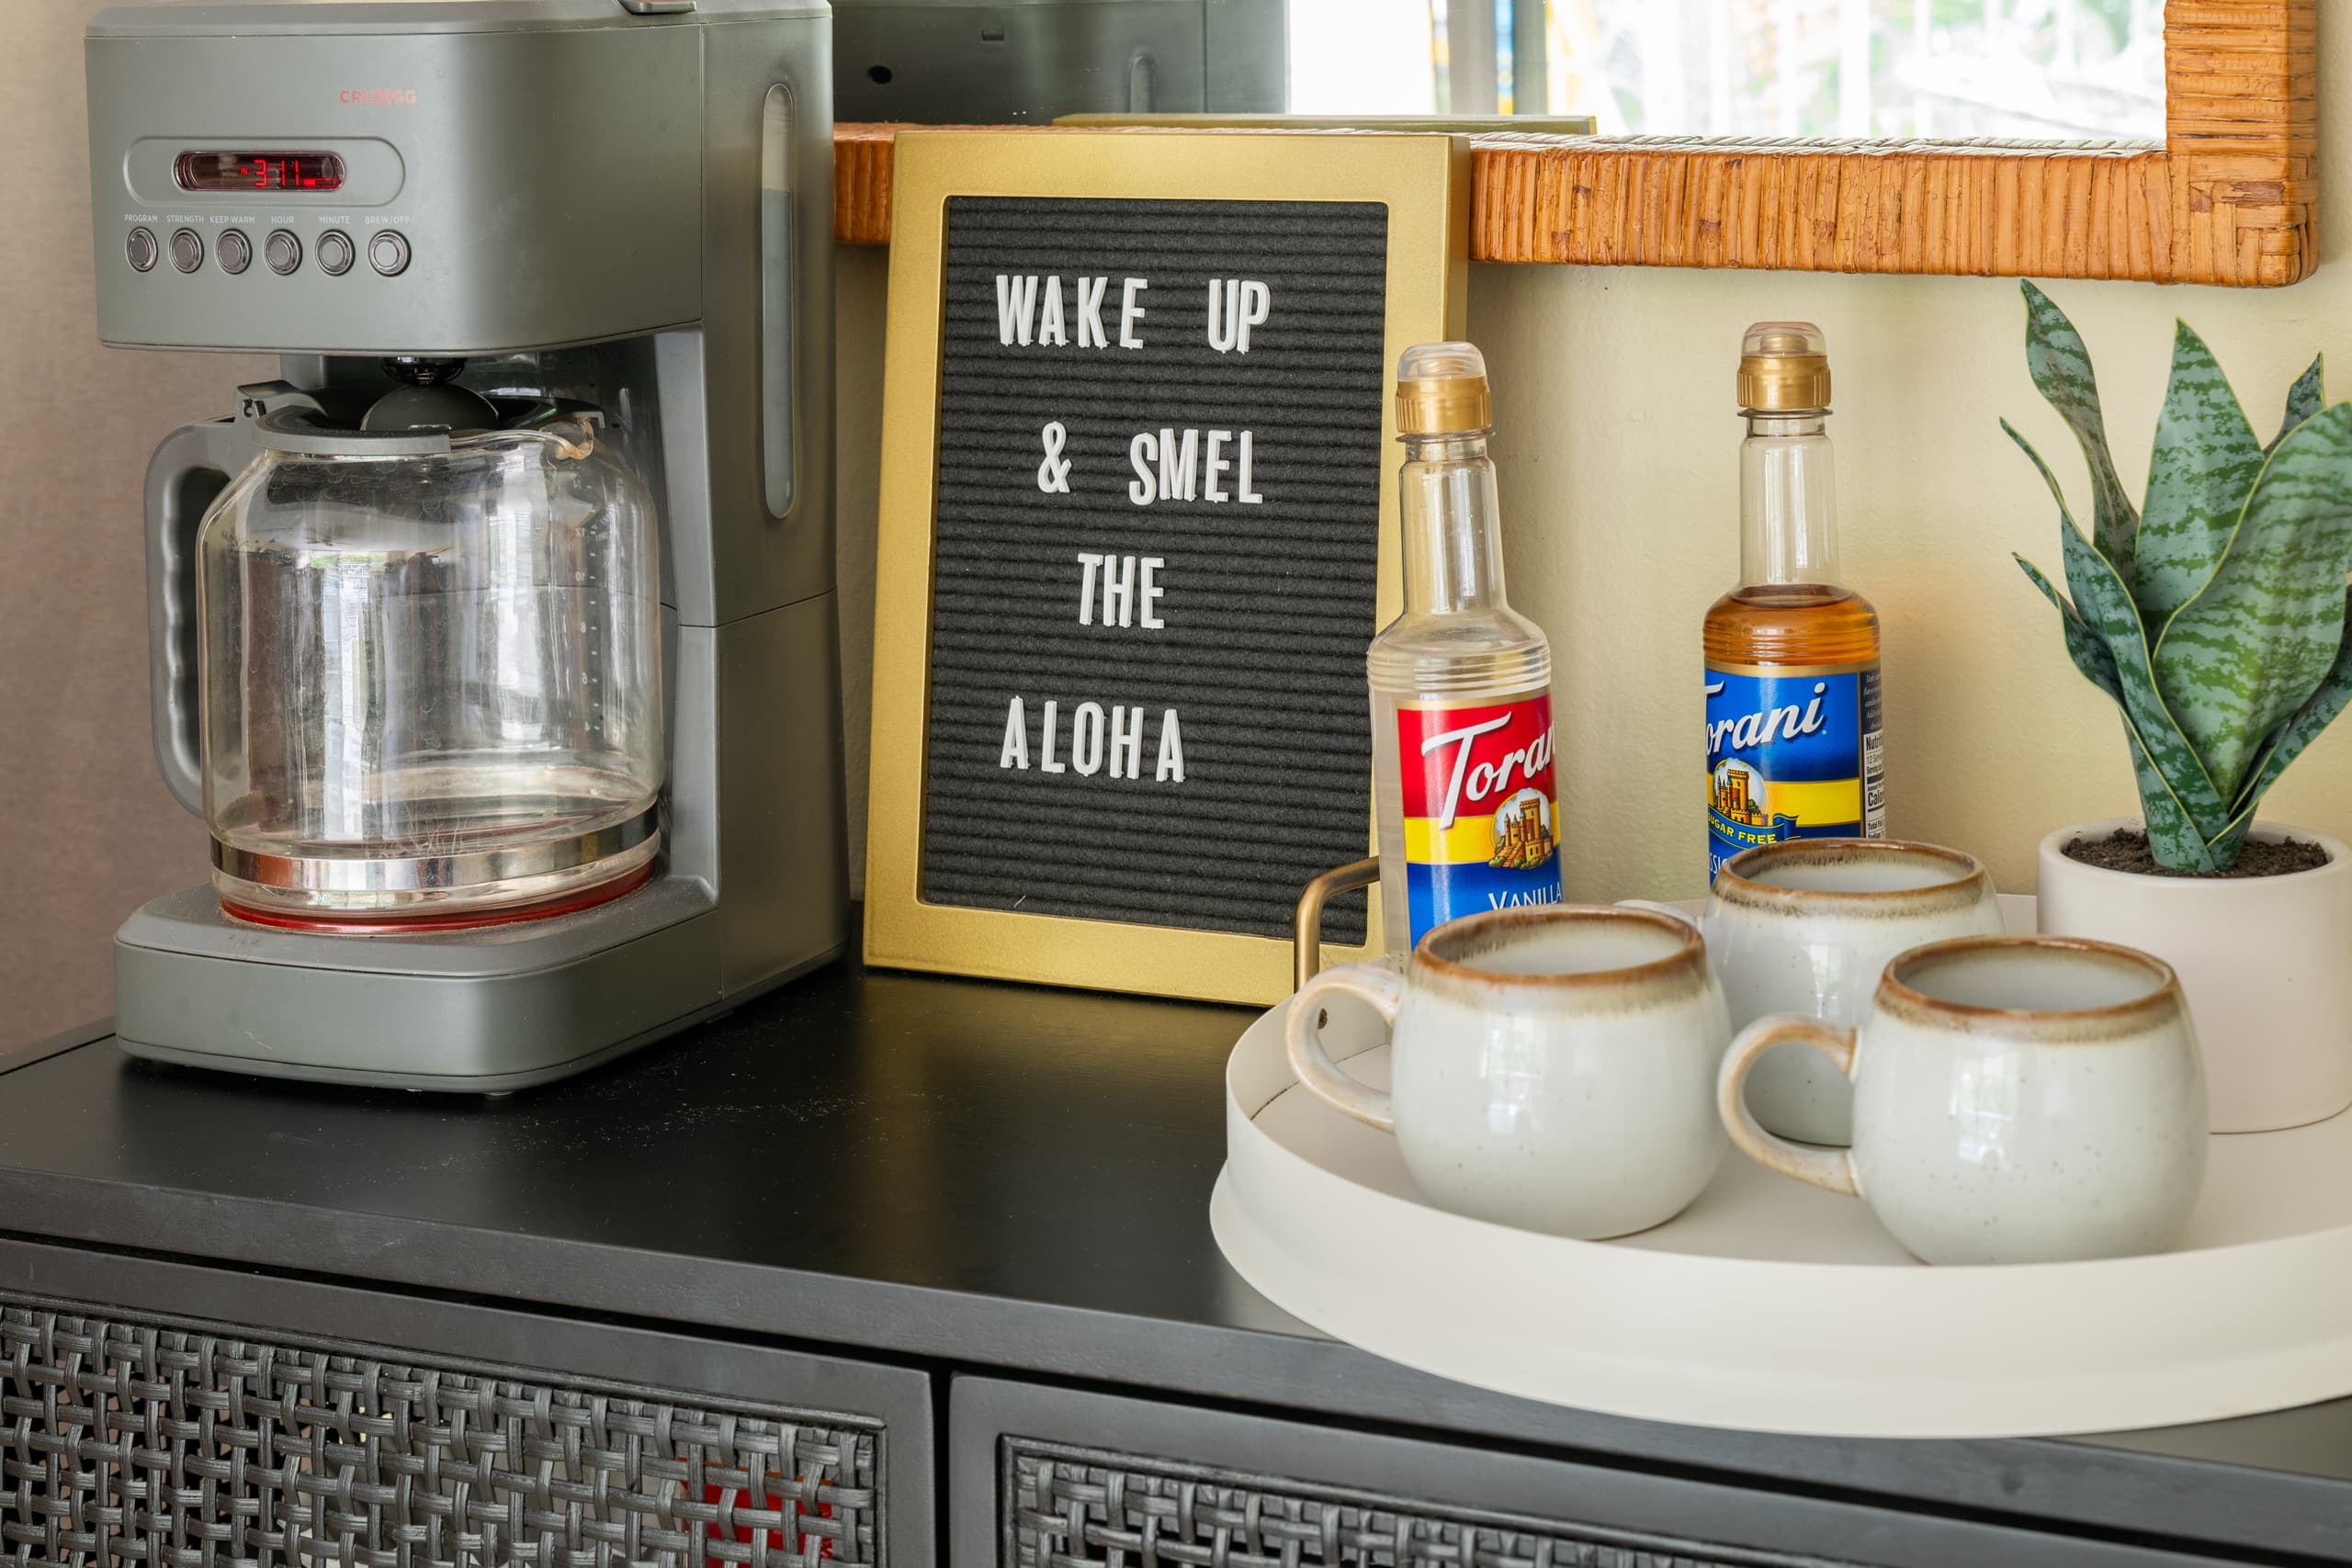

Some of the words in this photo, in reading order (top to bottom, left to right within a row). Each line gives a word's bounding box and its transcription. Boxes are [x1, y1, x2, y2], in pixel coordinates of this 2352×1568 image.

[254, 159, 300, 186] 3:11
[124, 214, 158, 222] PROGRAM
[166, 214, 205, 223] STRENGTH
[210, 215, 230, 223] KEEP
[231, 216, 255, 224] WARM
[271, 216, 294, 224] HOUR
[319, 215, 351, 224] MINUTE
[365, 216, 411, 224] BREW/OFF
[996, 275, 1148, 349] WAKE
[1207, 278, 1271, 354] UP
[1037, 421, 1073, 493] &
[1129, 428, 1263, 505] SMEL
[1077, 552, 1165, 629] THE
[1000, 695, 1186, 783] ALOHA
[1738, 830, 1778, 844] FREE
